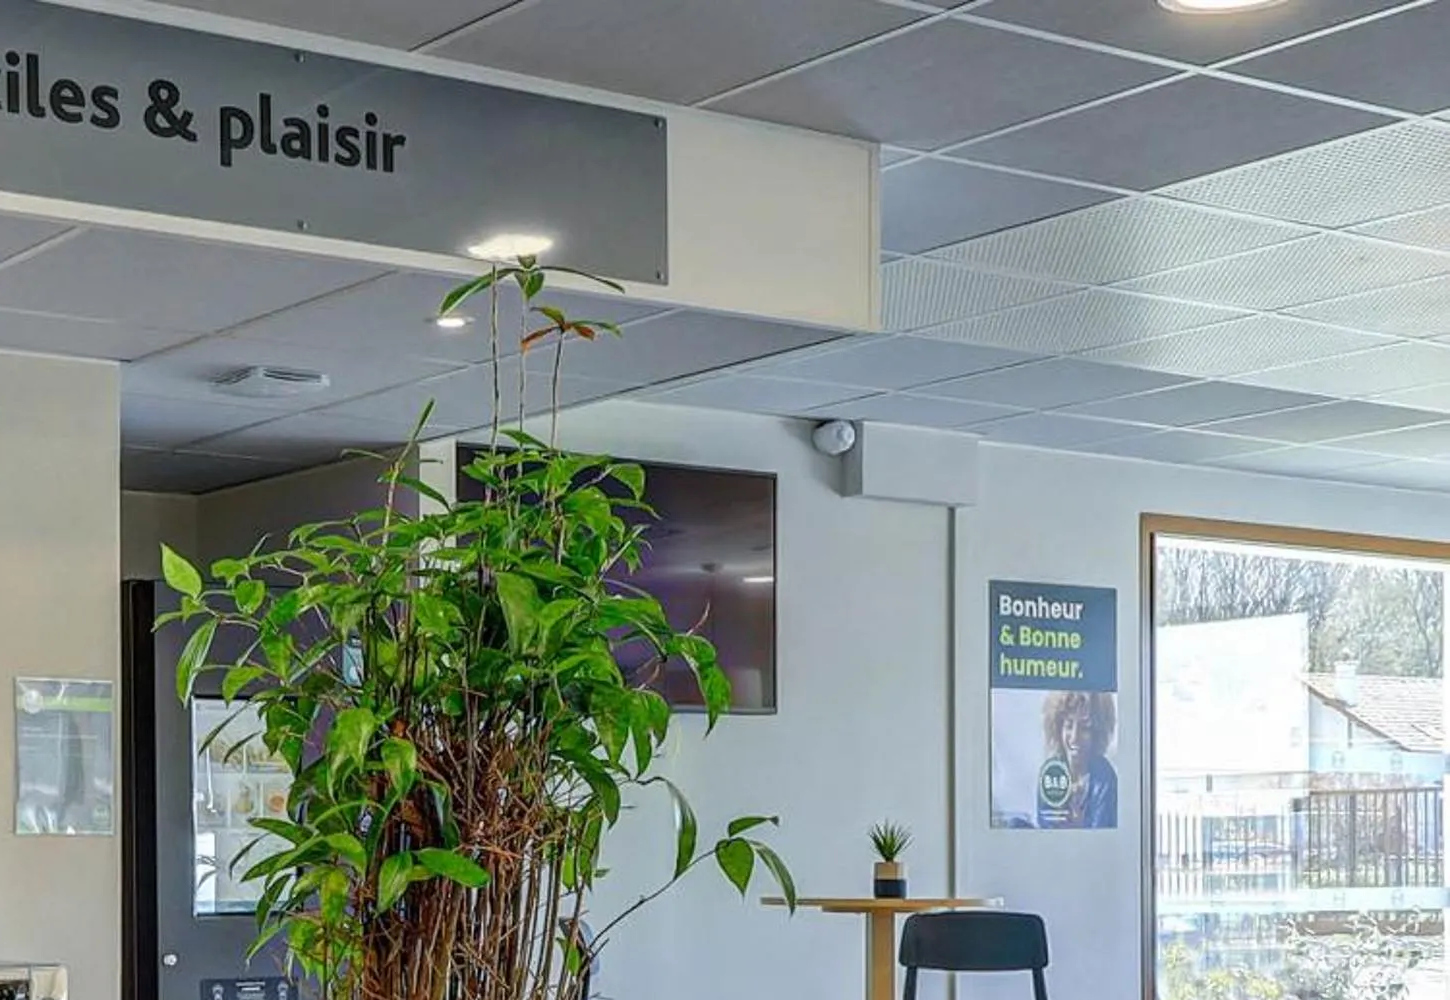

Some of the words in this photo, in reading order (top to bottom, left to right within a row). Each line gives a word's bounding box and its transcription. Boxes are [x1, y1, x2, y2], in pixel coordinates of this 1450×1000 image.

[143, 79, 198, 142] &
[220, 93, 407, 173] plaisir
[999, 594, 1084, 620] Bonheur
[999, 625, 1014, 646] &
[1020, 626, 1082, 650] Bonne
[1000, 652, 1084, 679] humeur.
